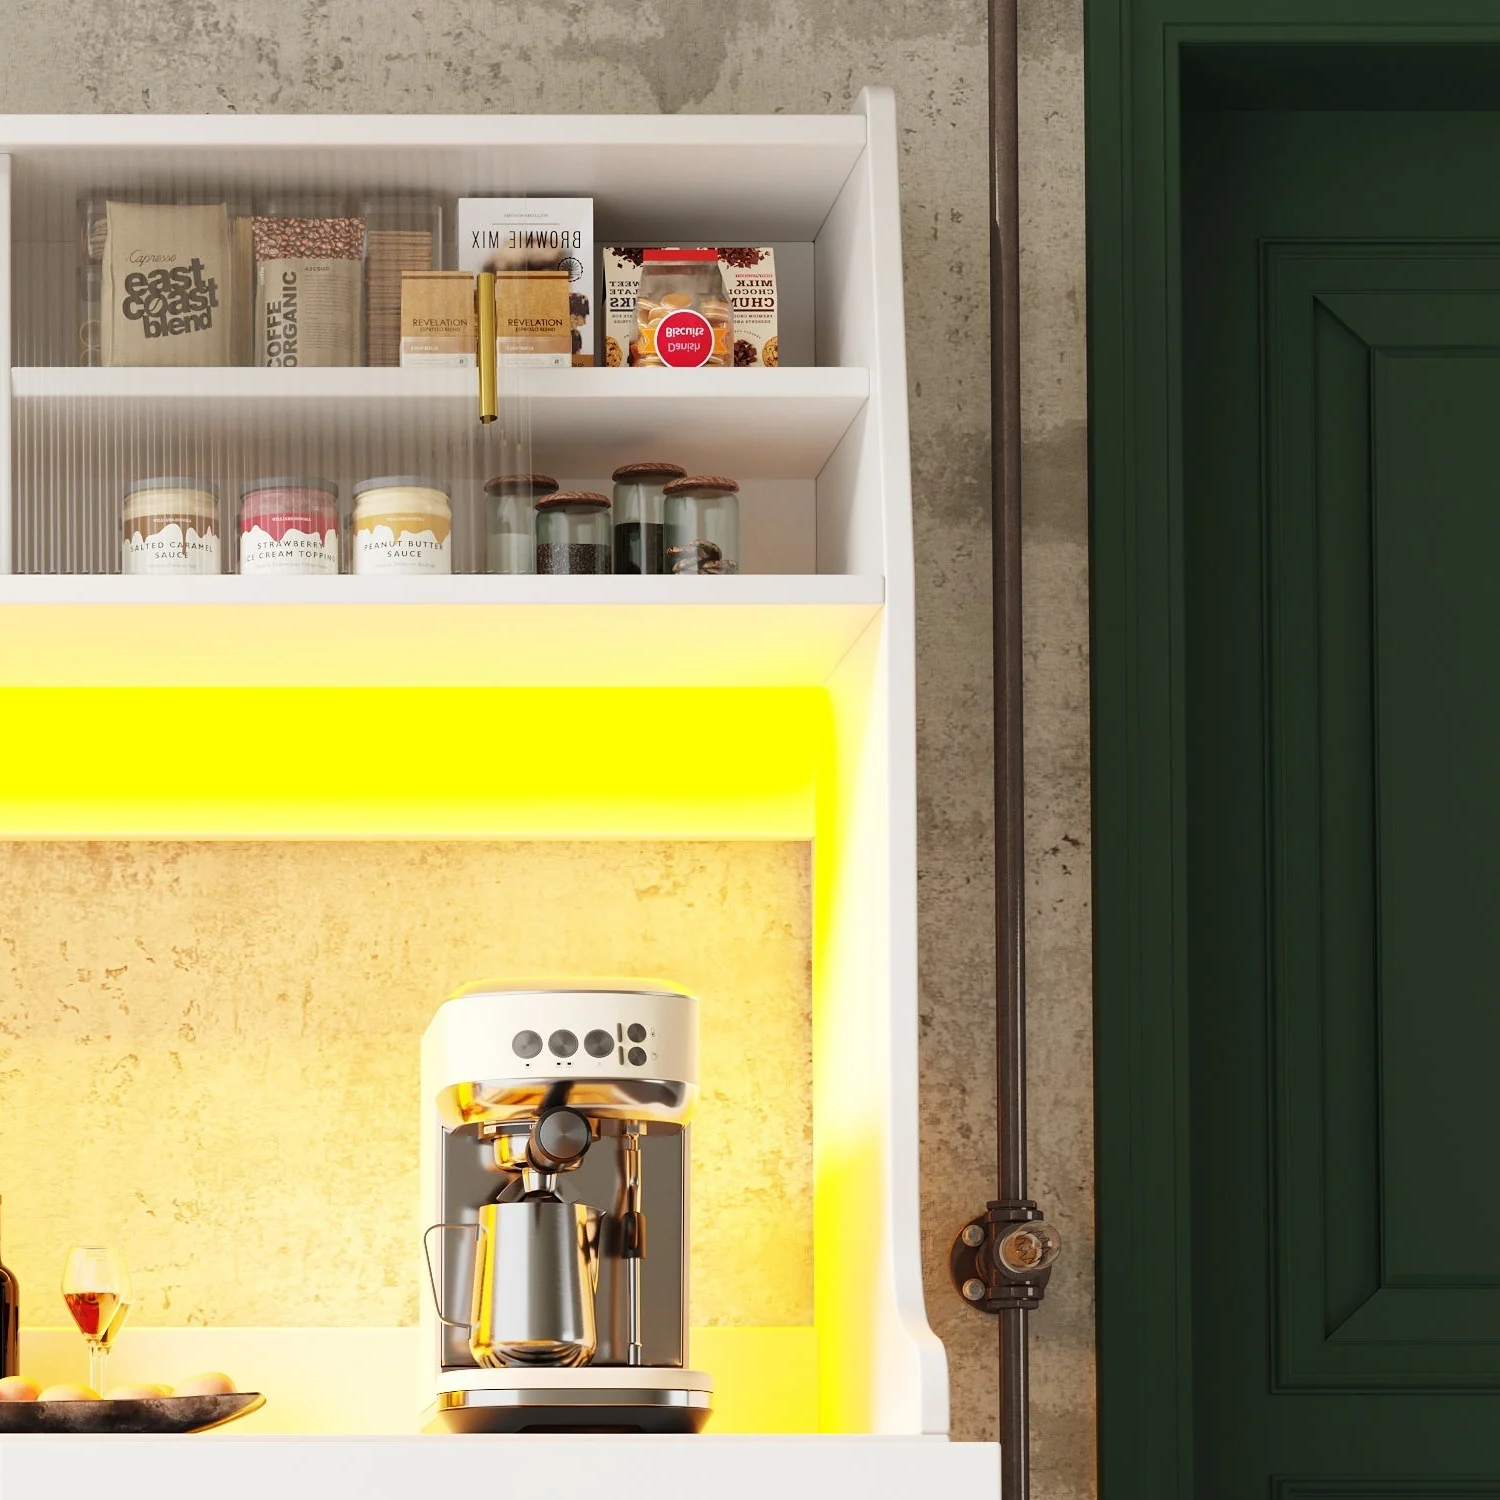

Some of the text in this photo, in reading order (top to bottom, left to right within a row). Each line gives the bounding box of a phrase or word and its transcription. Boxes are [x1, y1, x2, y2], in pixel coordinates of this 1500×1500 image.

[124, 257, 206, 297] east
[122, 277, 219, 321] coast
[143, 305, 213, 339] blend
[282, 271, 298, 367] ORGANIC
[412, 318, 468, 327] REVELATION
[507, 318, 563, 327] REVELATION
[130, 541, 213, 553] SALTED CARAMEL
[257, 540, 324, 550] STRAWBERRY
[364, 540, 444, 551] PEANUT BUTTER
[154, 551, 189, 559] SAUCE
[258, 550, 293, 559] CREAM
[298, 550, 336, 563] TOPPING
[387, 550, 422, 558] SAUCE
